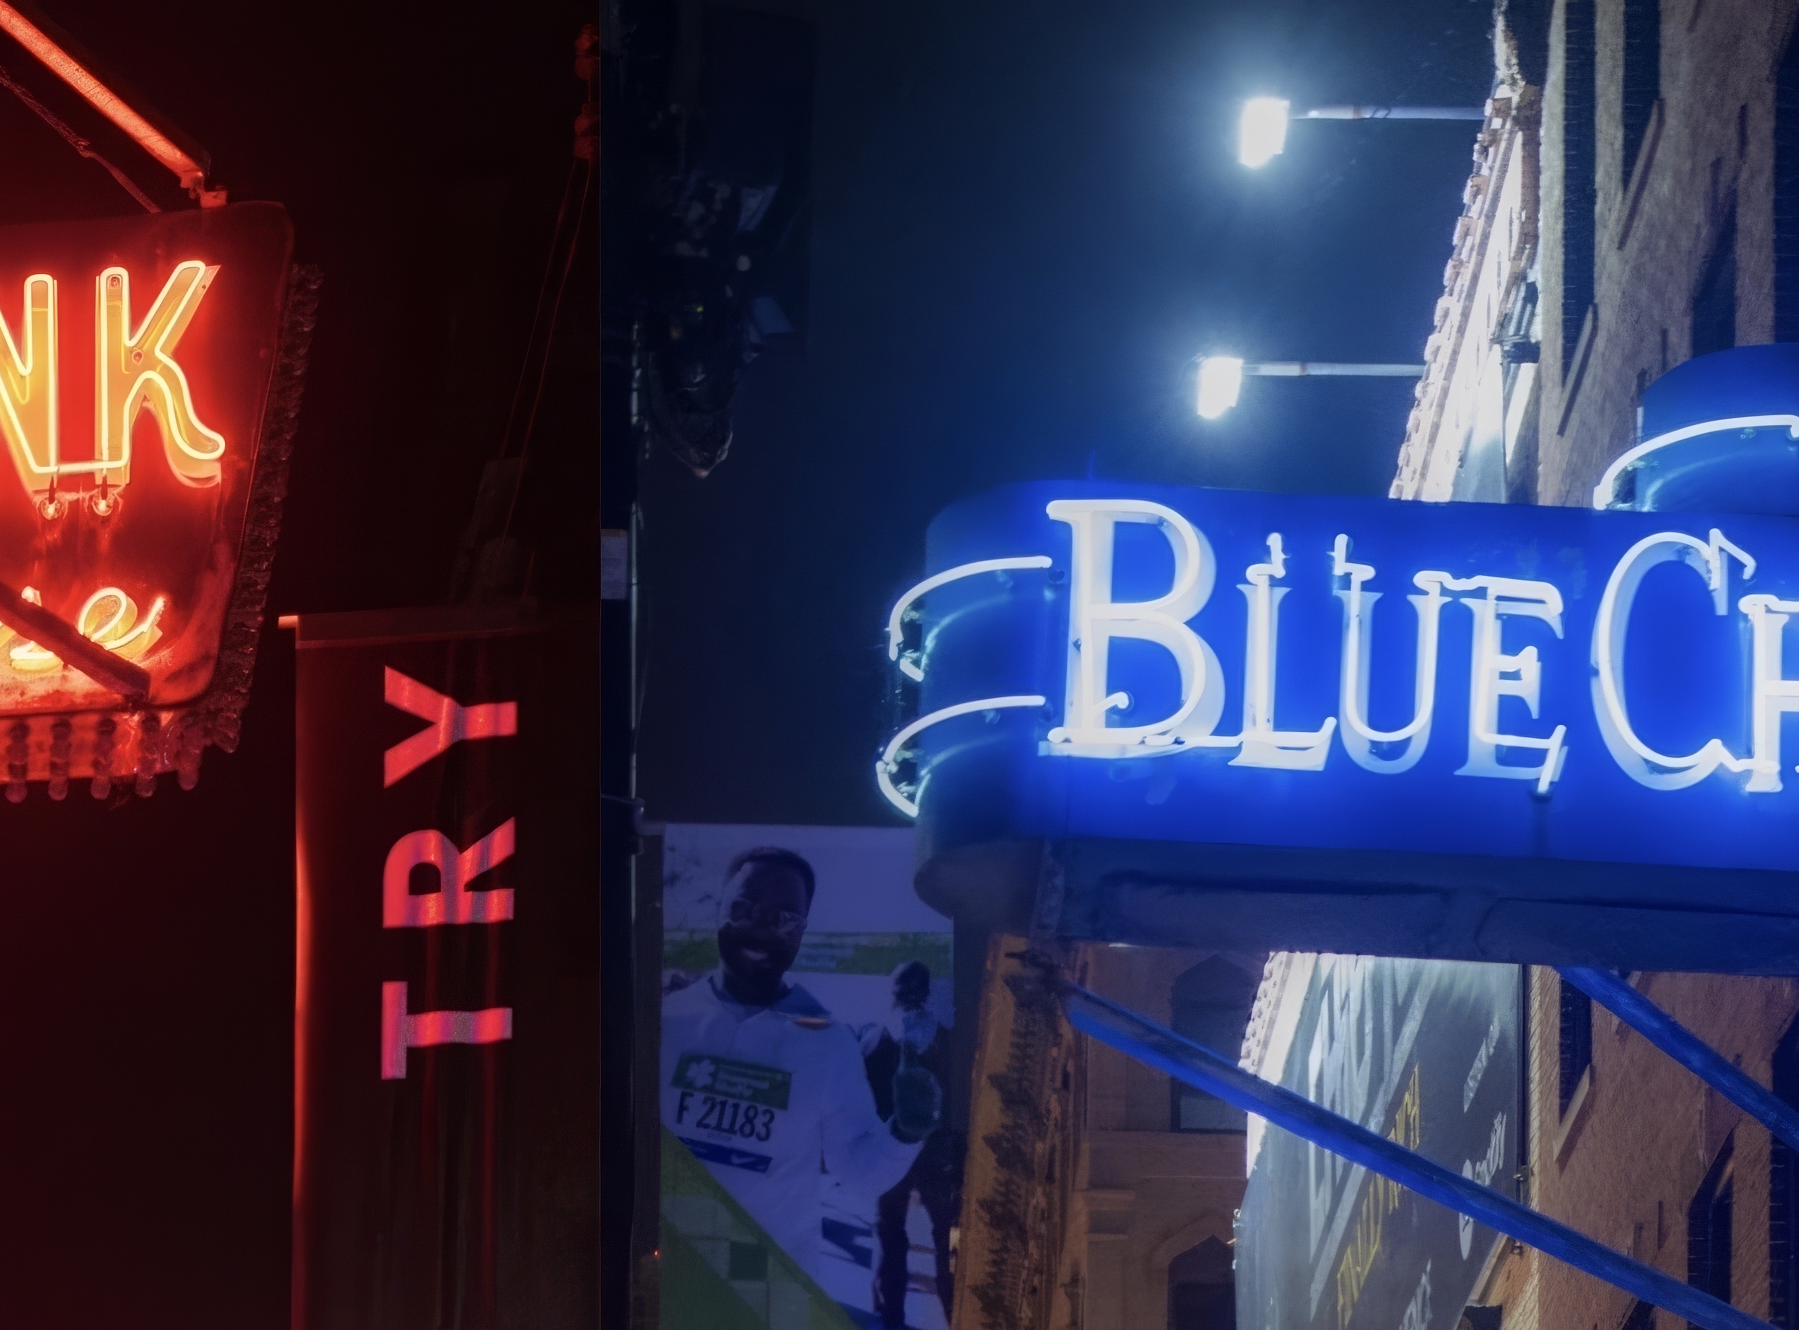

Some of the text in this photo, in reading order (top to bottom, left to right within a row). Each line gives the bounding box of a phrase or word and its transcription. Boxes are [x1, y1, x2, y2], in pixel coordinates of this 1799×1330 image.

[1038, 497, 1566, 796] BLUE
[381, 665, 518, 1080] TRY
[676, 1091, 775, 1141] F 21183
